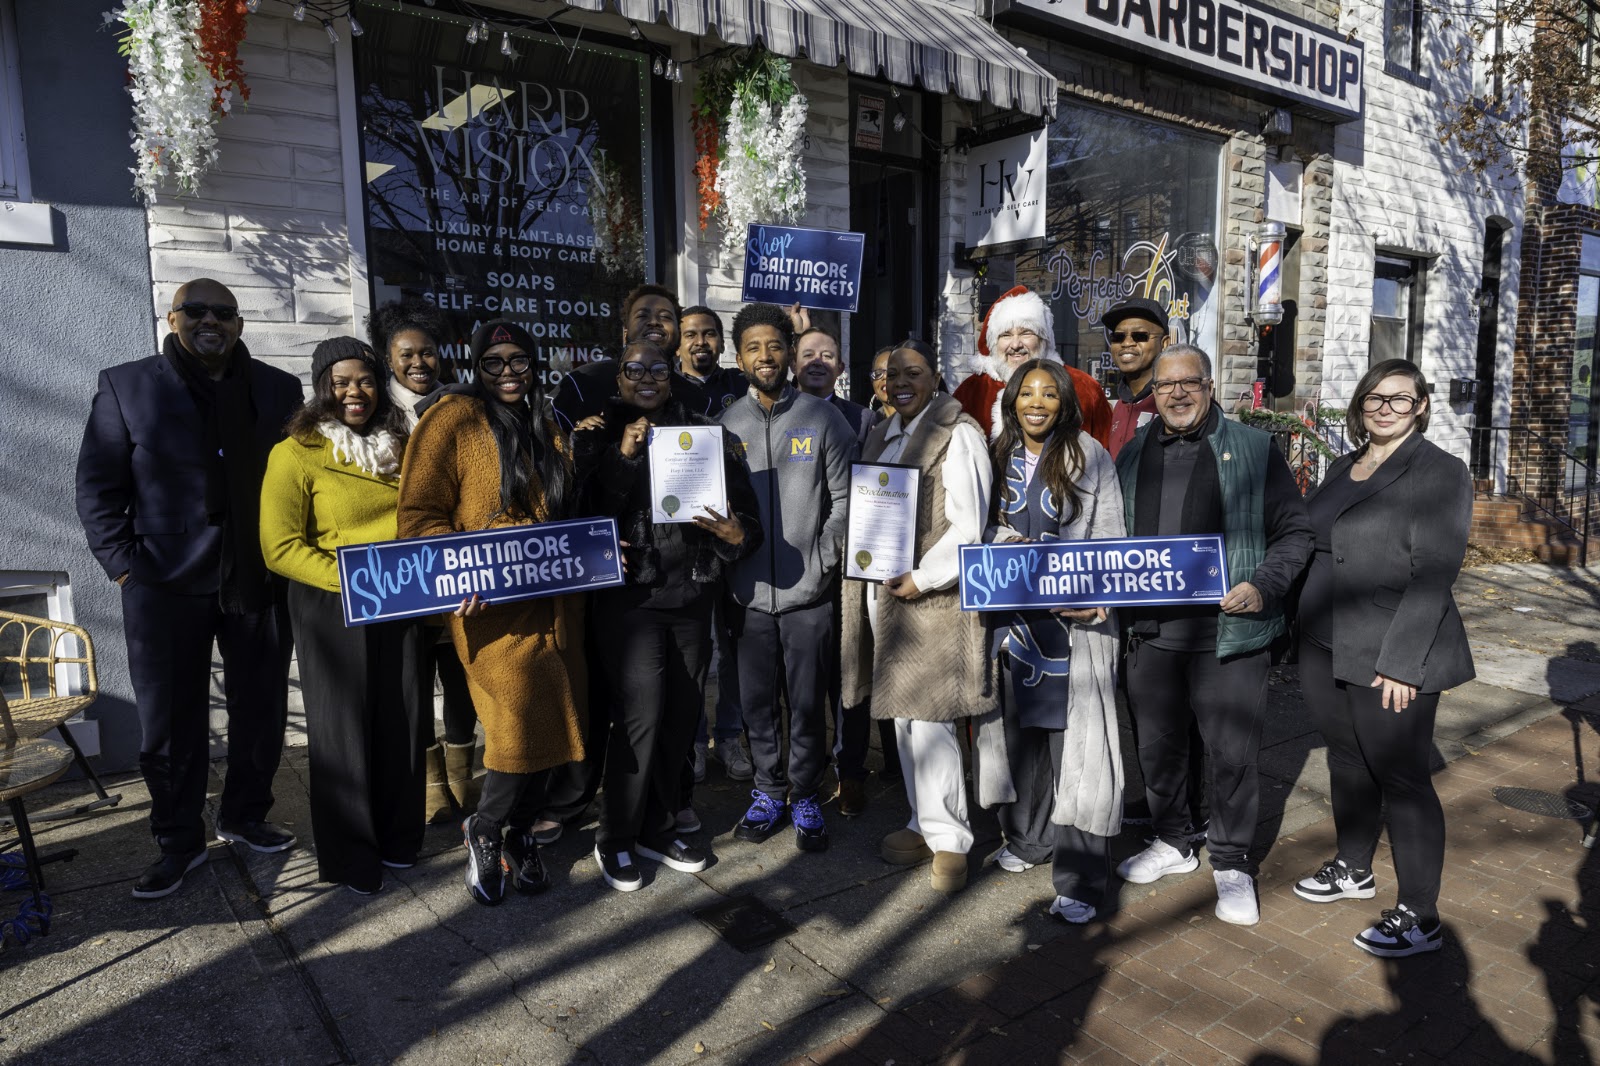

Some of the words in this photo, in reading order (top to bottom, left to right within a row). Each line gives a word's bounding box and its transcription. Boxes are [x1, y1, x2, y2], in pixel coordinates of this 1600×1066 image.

[432, 65, 589, 138] HARP
[411, 119, 608, 196] VISION
[419, 186, 450, 201] THE
[459, 192, 490, 206] ART
[499, 196, 518, 208] OF
[526, 200, 562, 213] SELF
[569, 204, 607, 219] CARE
[983, 207, 995, 215] ART
[1006, 203, 1021, 211] SELF
[1022, 199, 1039, 208] CARE
[426, 219, 492, 238] LUXURY
[498, 226, 604, 248] PLANT-BASED
[747, 227, 794, 266] Shop
[436, 238, 486, 254] HOME
[493, 244, 503, 256] &
[510, 244, 551, 260] BODY
[558, 249, 597, 264] CARE
[758, 256, 848, 279] BALTIMORE
[487, 271, 555, 291] SOAPS
[749, 272, 790, 291] MAIN
[795, 276, 854, 297] STREETS
[1048, 248, 1123, 317] Perfect
[423, 292, 538, 314] SELF-CARE
[545, 299, 611, 317] TOOLS
[538, 346, 603, 362] LIVING
[791, 437, 813, 455] M
[857, 485, 909, 499] Proclamation
[350, 543, 438, 620] Shop
[443, 534, 571, 571] BALTIMORE
[435, 568, 496, 598] MAIN
[503, 556, 585, 588] STREETS
[967, 543, 1043, 608] Shop
[1048, 548, 1172, 573] BALTIMORE
[1039, 574, 1095, 596] MAIN
[1101, 570, 1186, 594] STREETS
